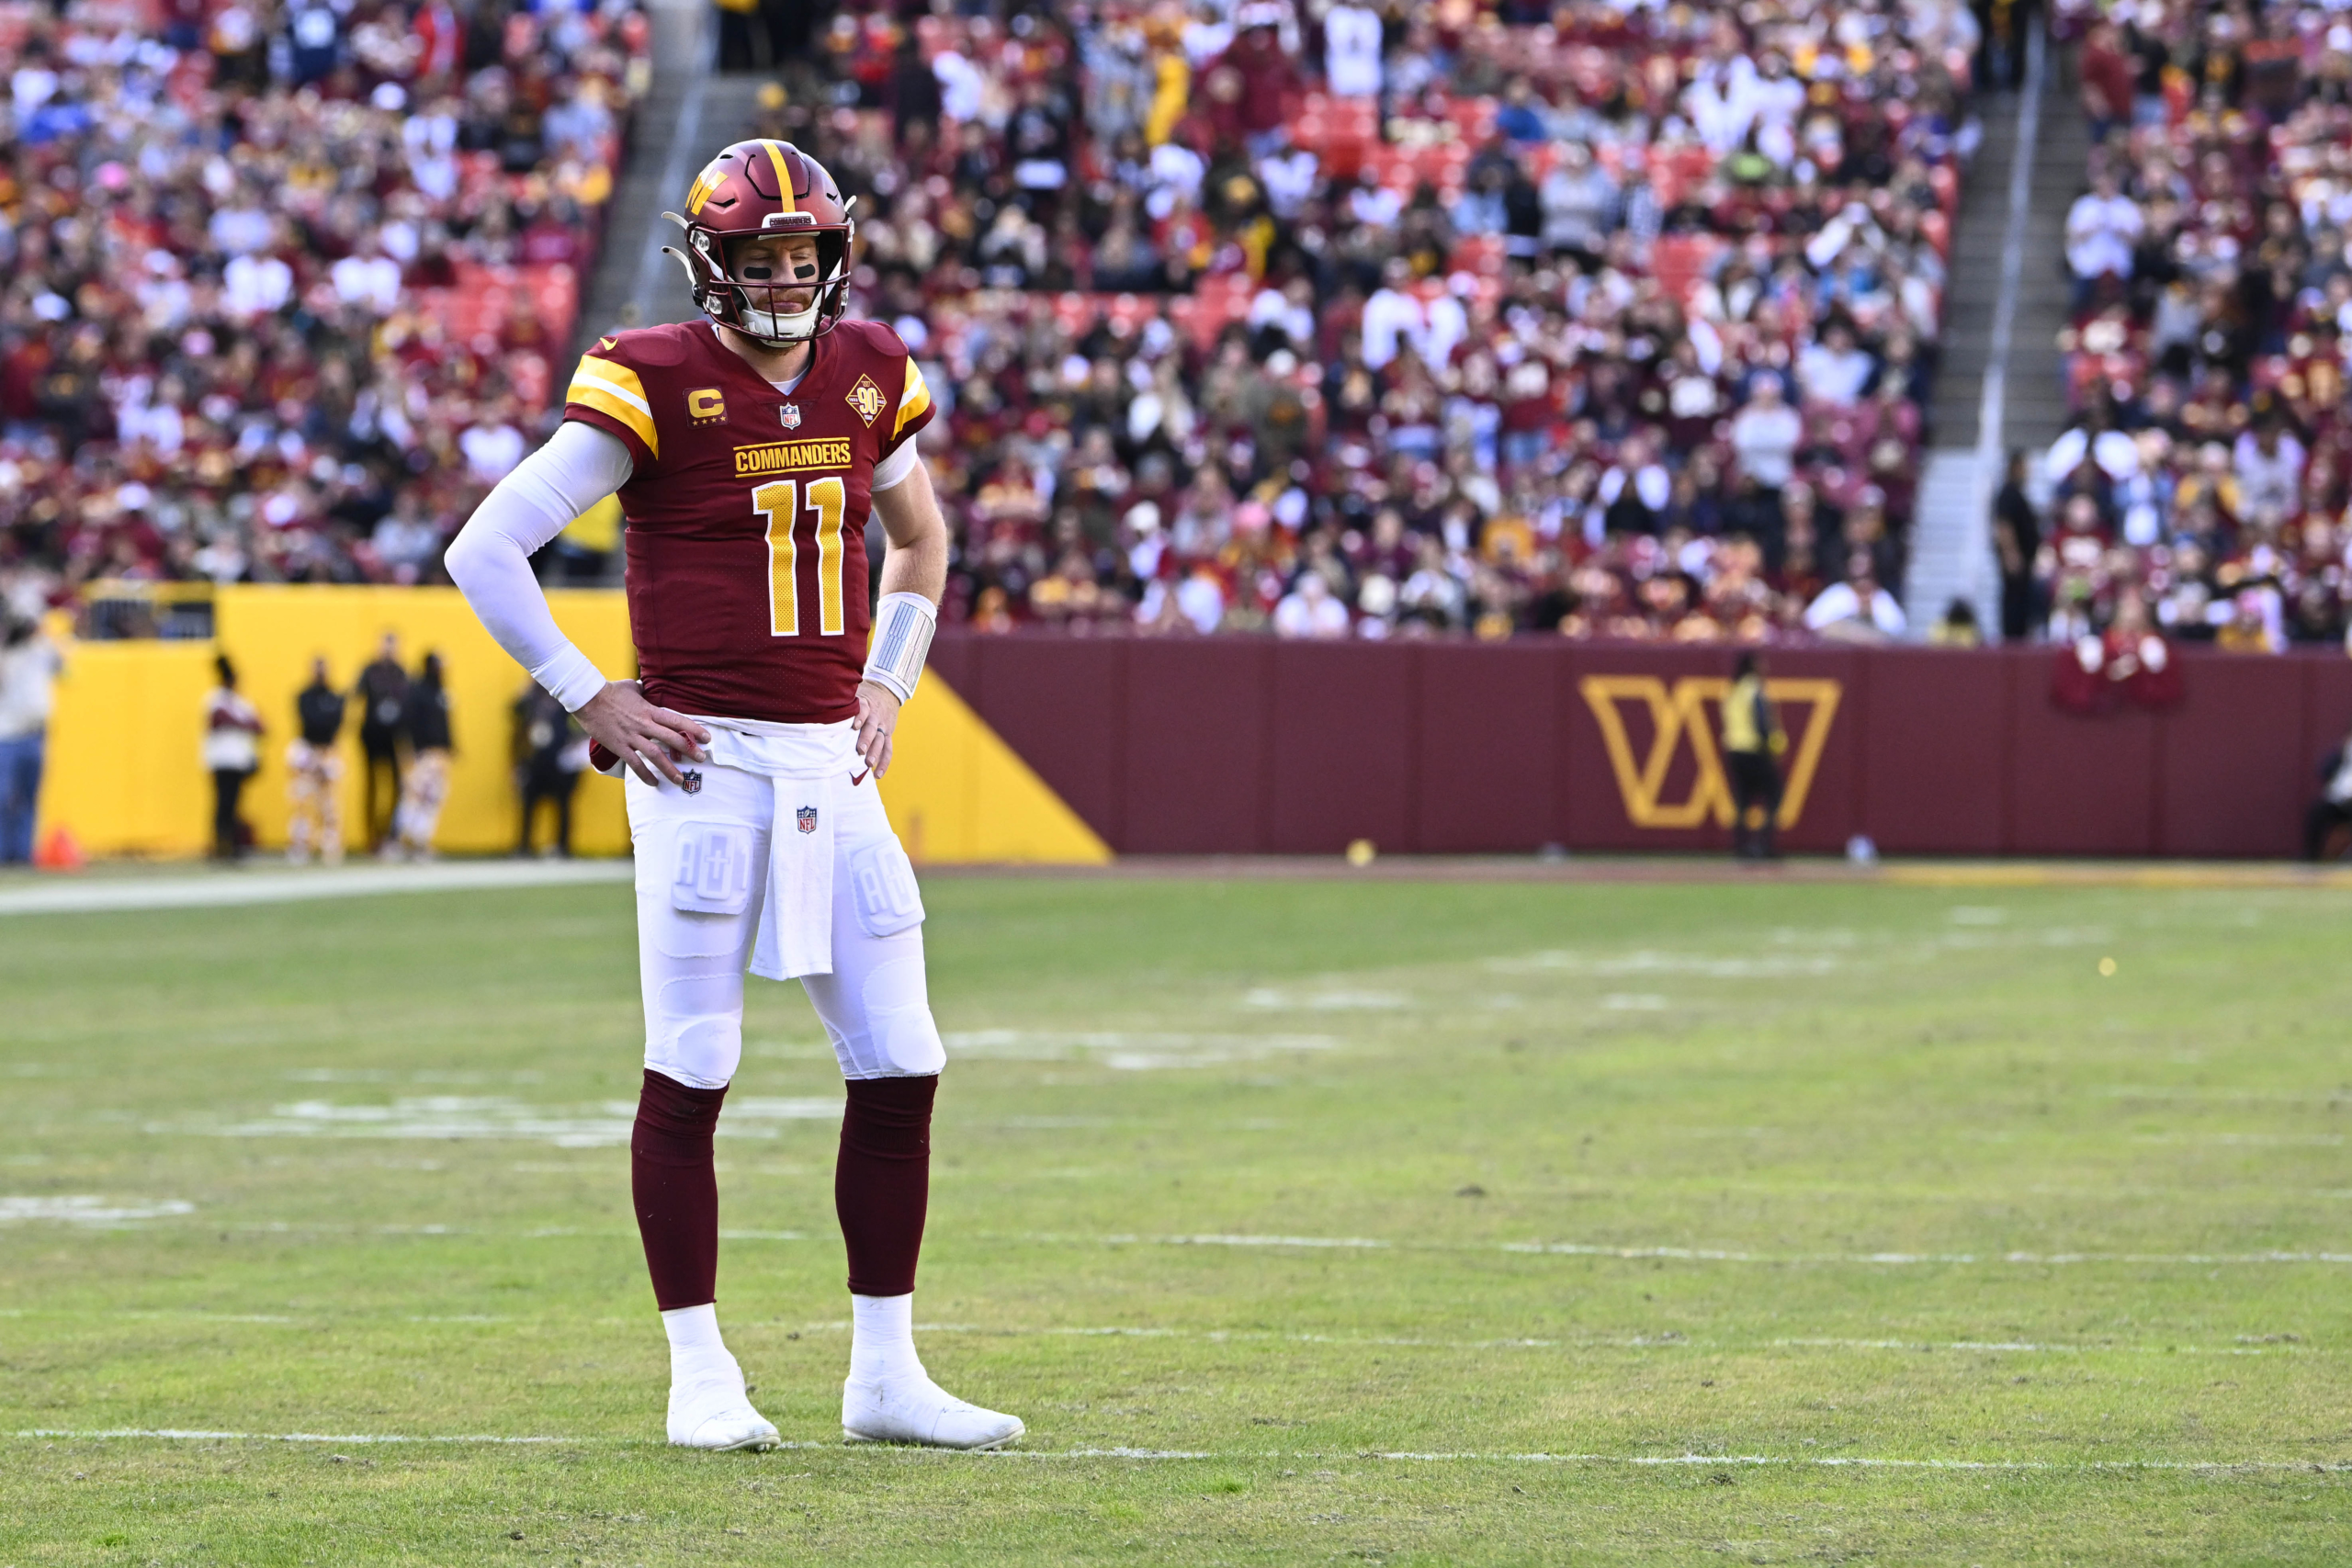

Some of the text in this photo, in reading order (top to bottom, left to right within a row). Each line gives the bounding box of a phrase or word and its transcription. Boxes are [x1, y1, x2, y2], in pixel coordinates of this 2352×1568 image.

[687, 389, 725, 419] C
[856, 387, 878, 415] 90
[784, 413, 798, 425] NFL
[735, 443, 852, 472] COMMANDERS
[751, 477, 846, 637] 11
[684, 780, 699, 791] NFL
[798, 818, 815, 831] NFL
